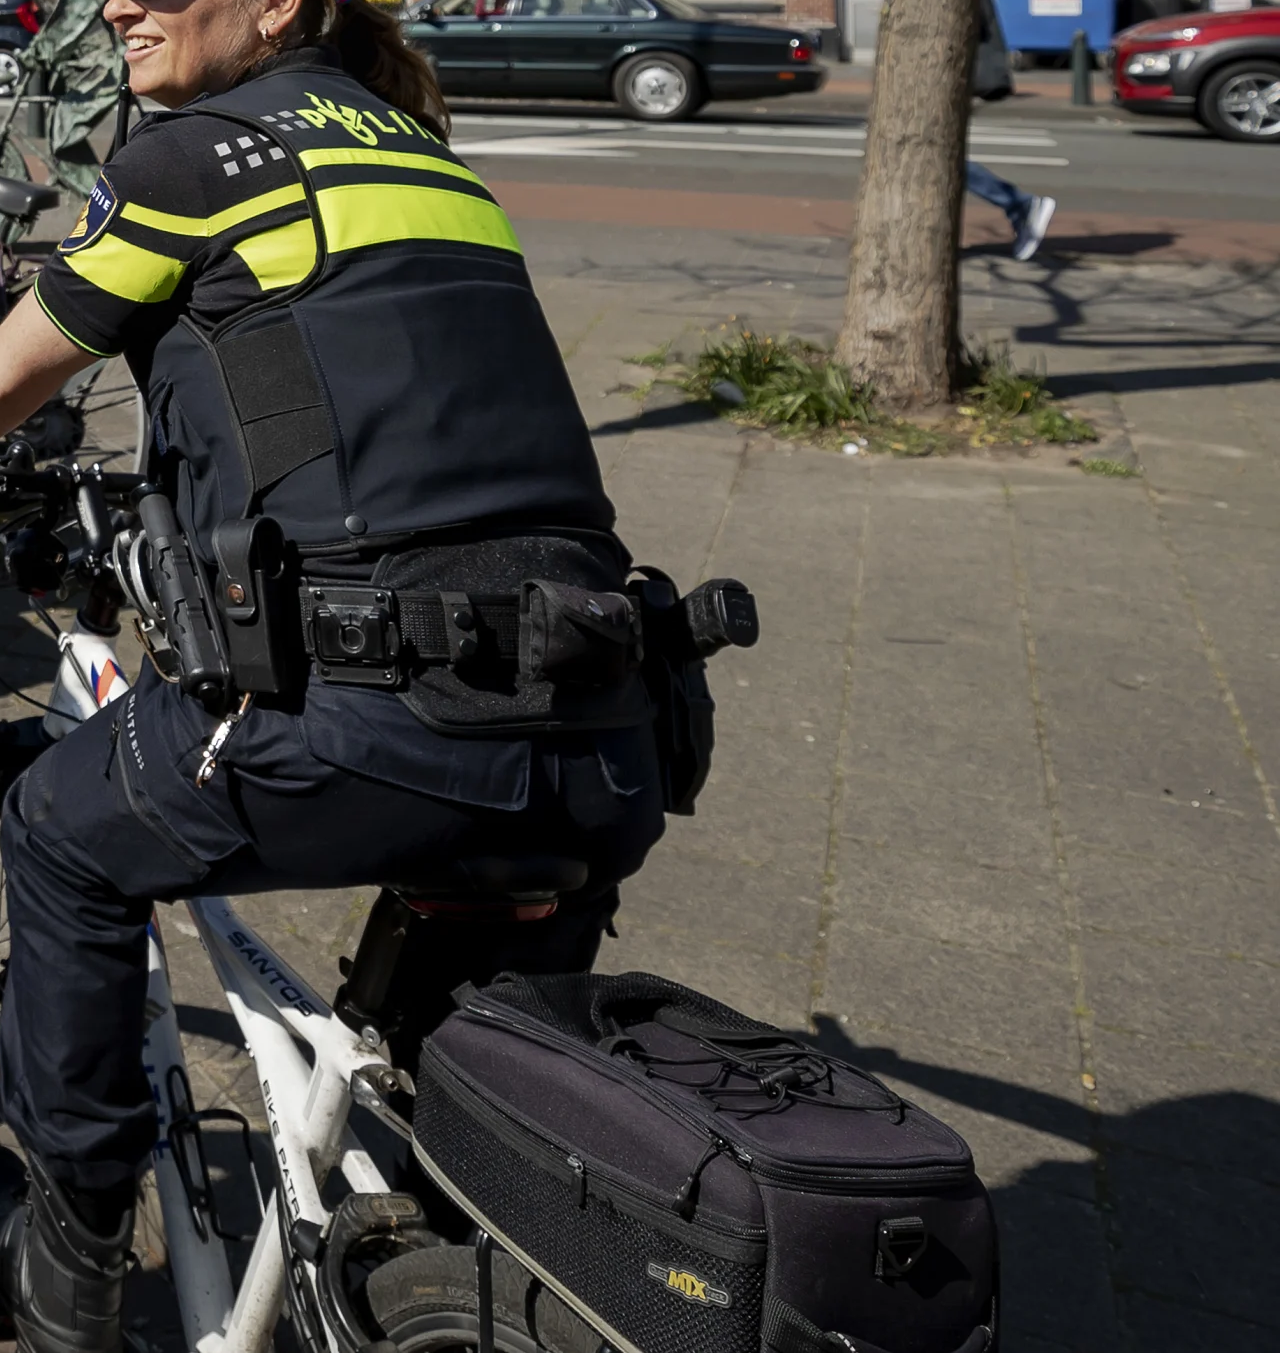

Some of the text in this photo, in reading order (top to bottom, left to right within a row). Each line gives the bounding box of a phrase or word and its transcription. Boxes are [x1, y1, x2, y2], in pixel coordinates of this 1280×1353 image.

[227, 931, 319, 1017] SANTOS
[262, 1079, 280, 1138] BIKE
[668, 1270, 706, 1299] MTX
